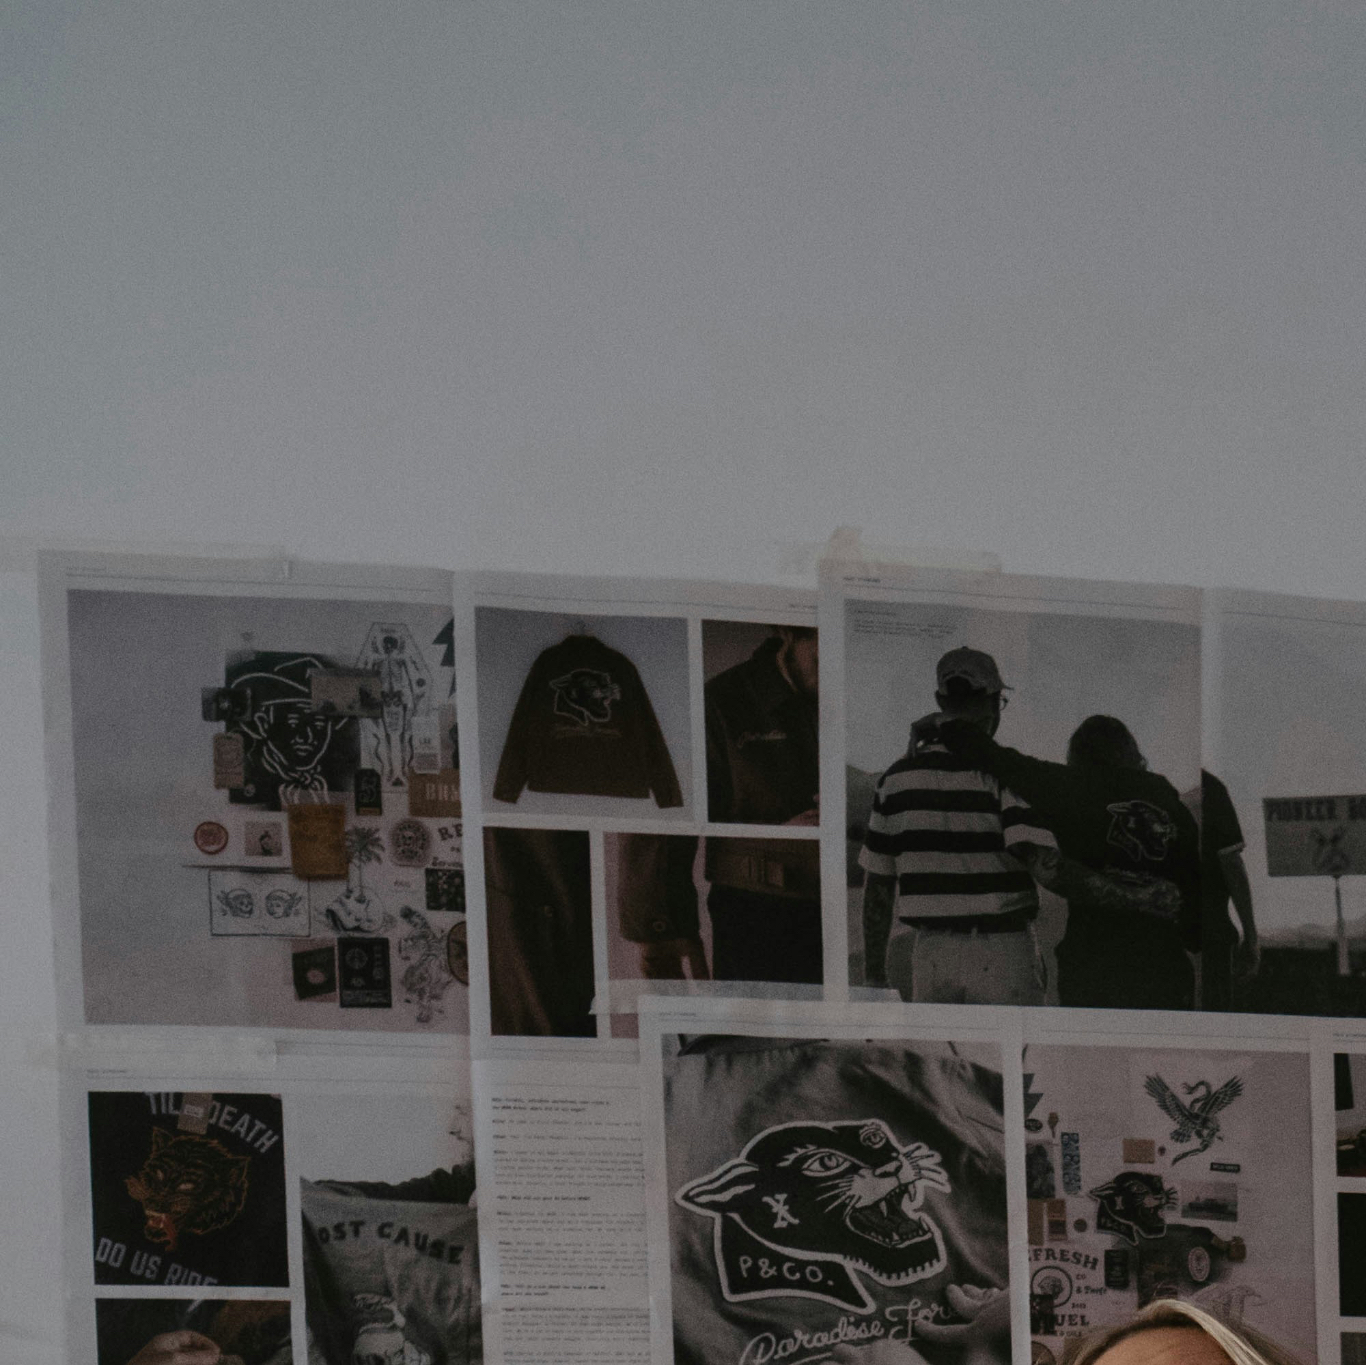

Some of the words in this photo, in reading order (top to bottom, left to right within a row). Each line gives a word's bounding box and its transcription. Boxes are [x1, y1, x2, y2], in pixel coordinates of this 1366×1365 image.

[207, 1100, 280, 1153] DEATH
[95, 1237, 124, 1269] DO
[130, 1248, 163, 1280] US
[376, 1220, 464, 1266] CAUSE
